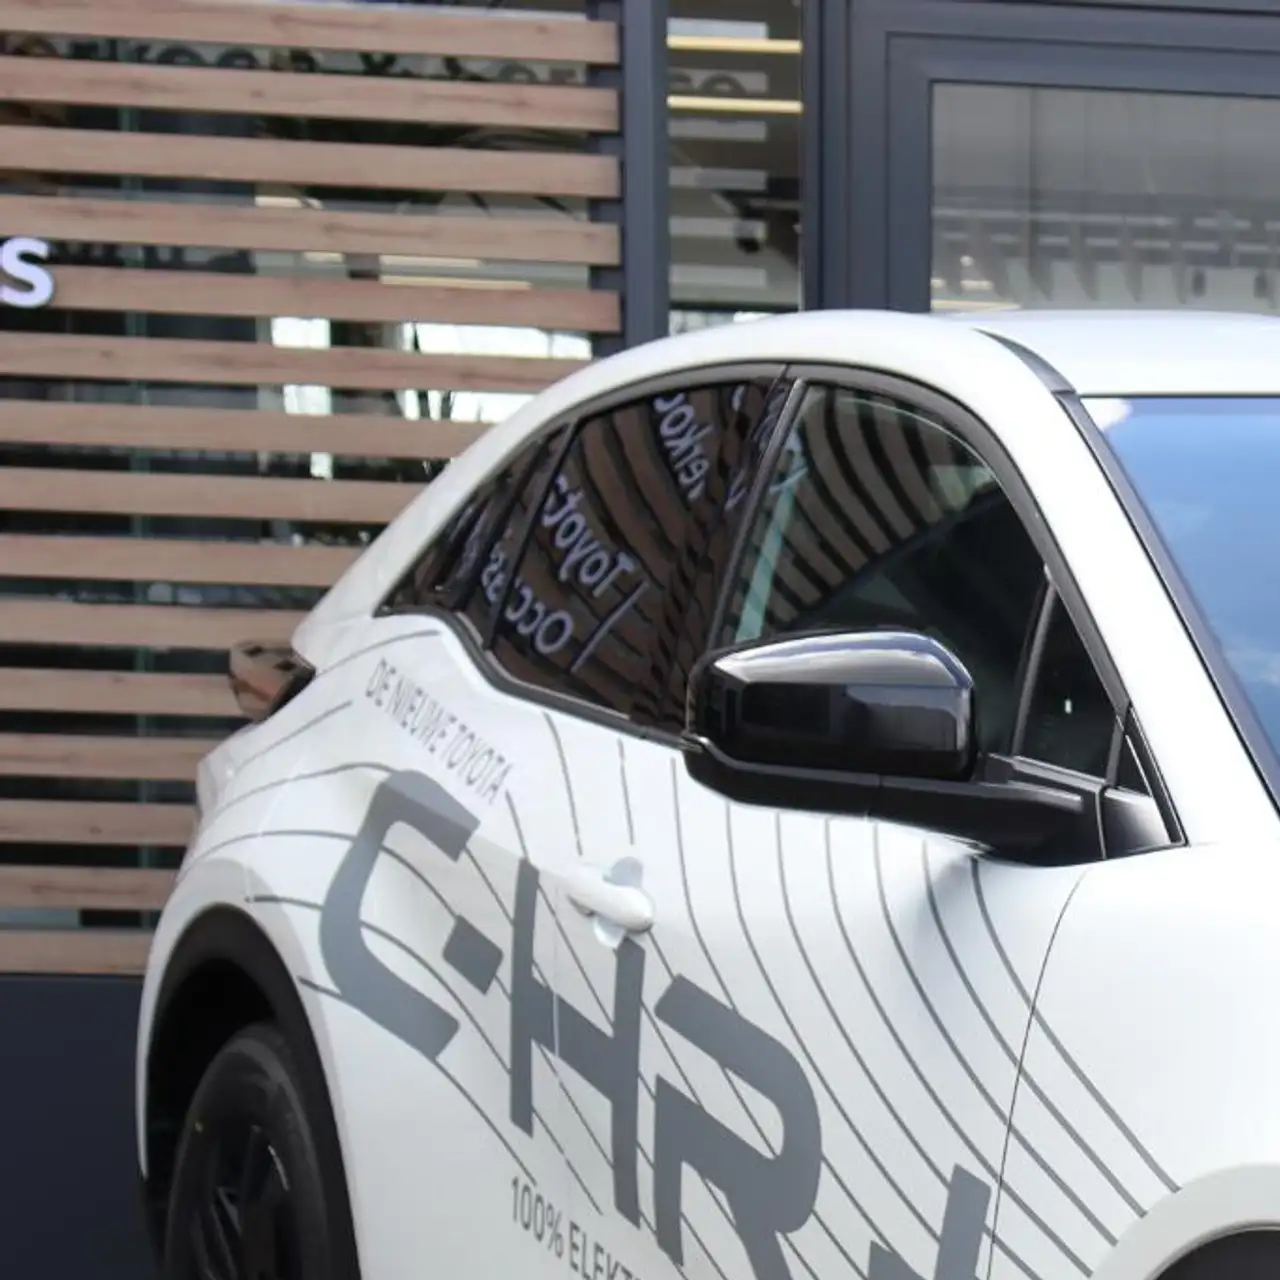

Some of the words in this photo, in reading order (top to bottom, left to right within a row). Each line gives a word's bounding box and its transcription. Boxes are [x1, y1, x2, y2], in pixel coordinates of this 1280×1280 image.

[365, 657, 397, 708] DE
[384, 675, 458, 755] NIEUWE
[438, 723, 514, 806] TOYOTA
[511, 1175, 565, 1261] 100%
